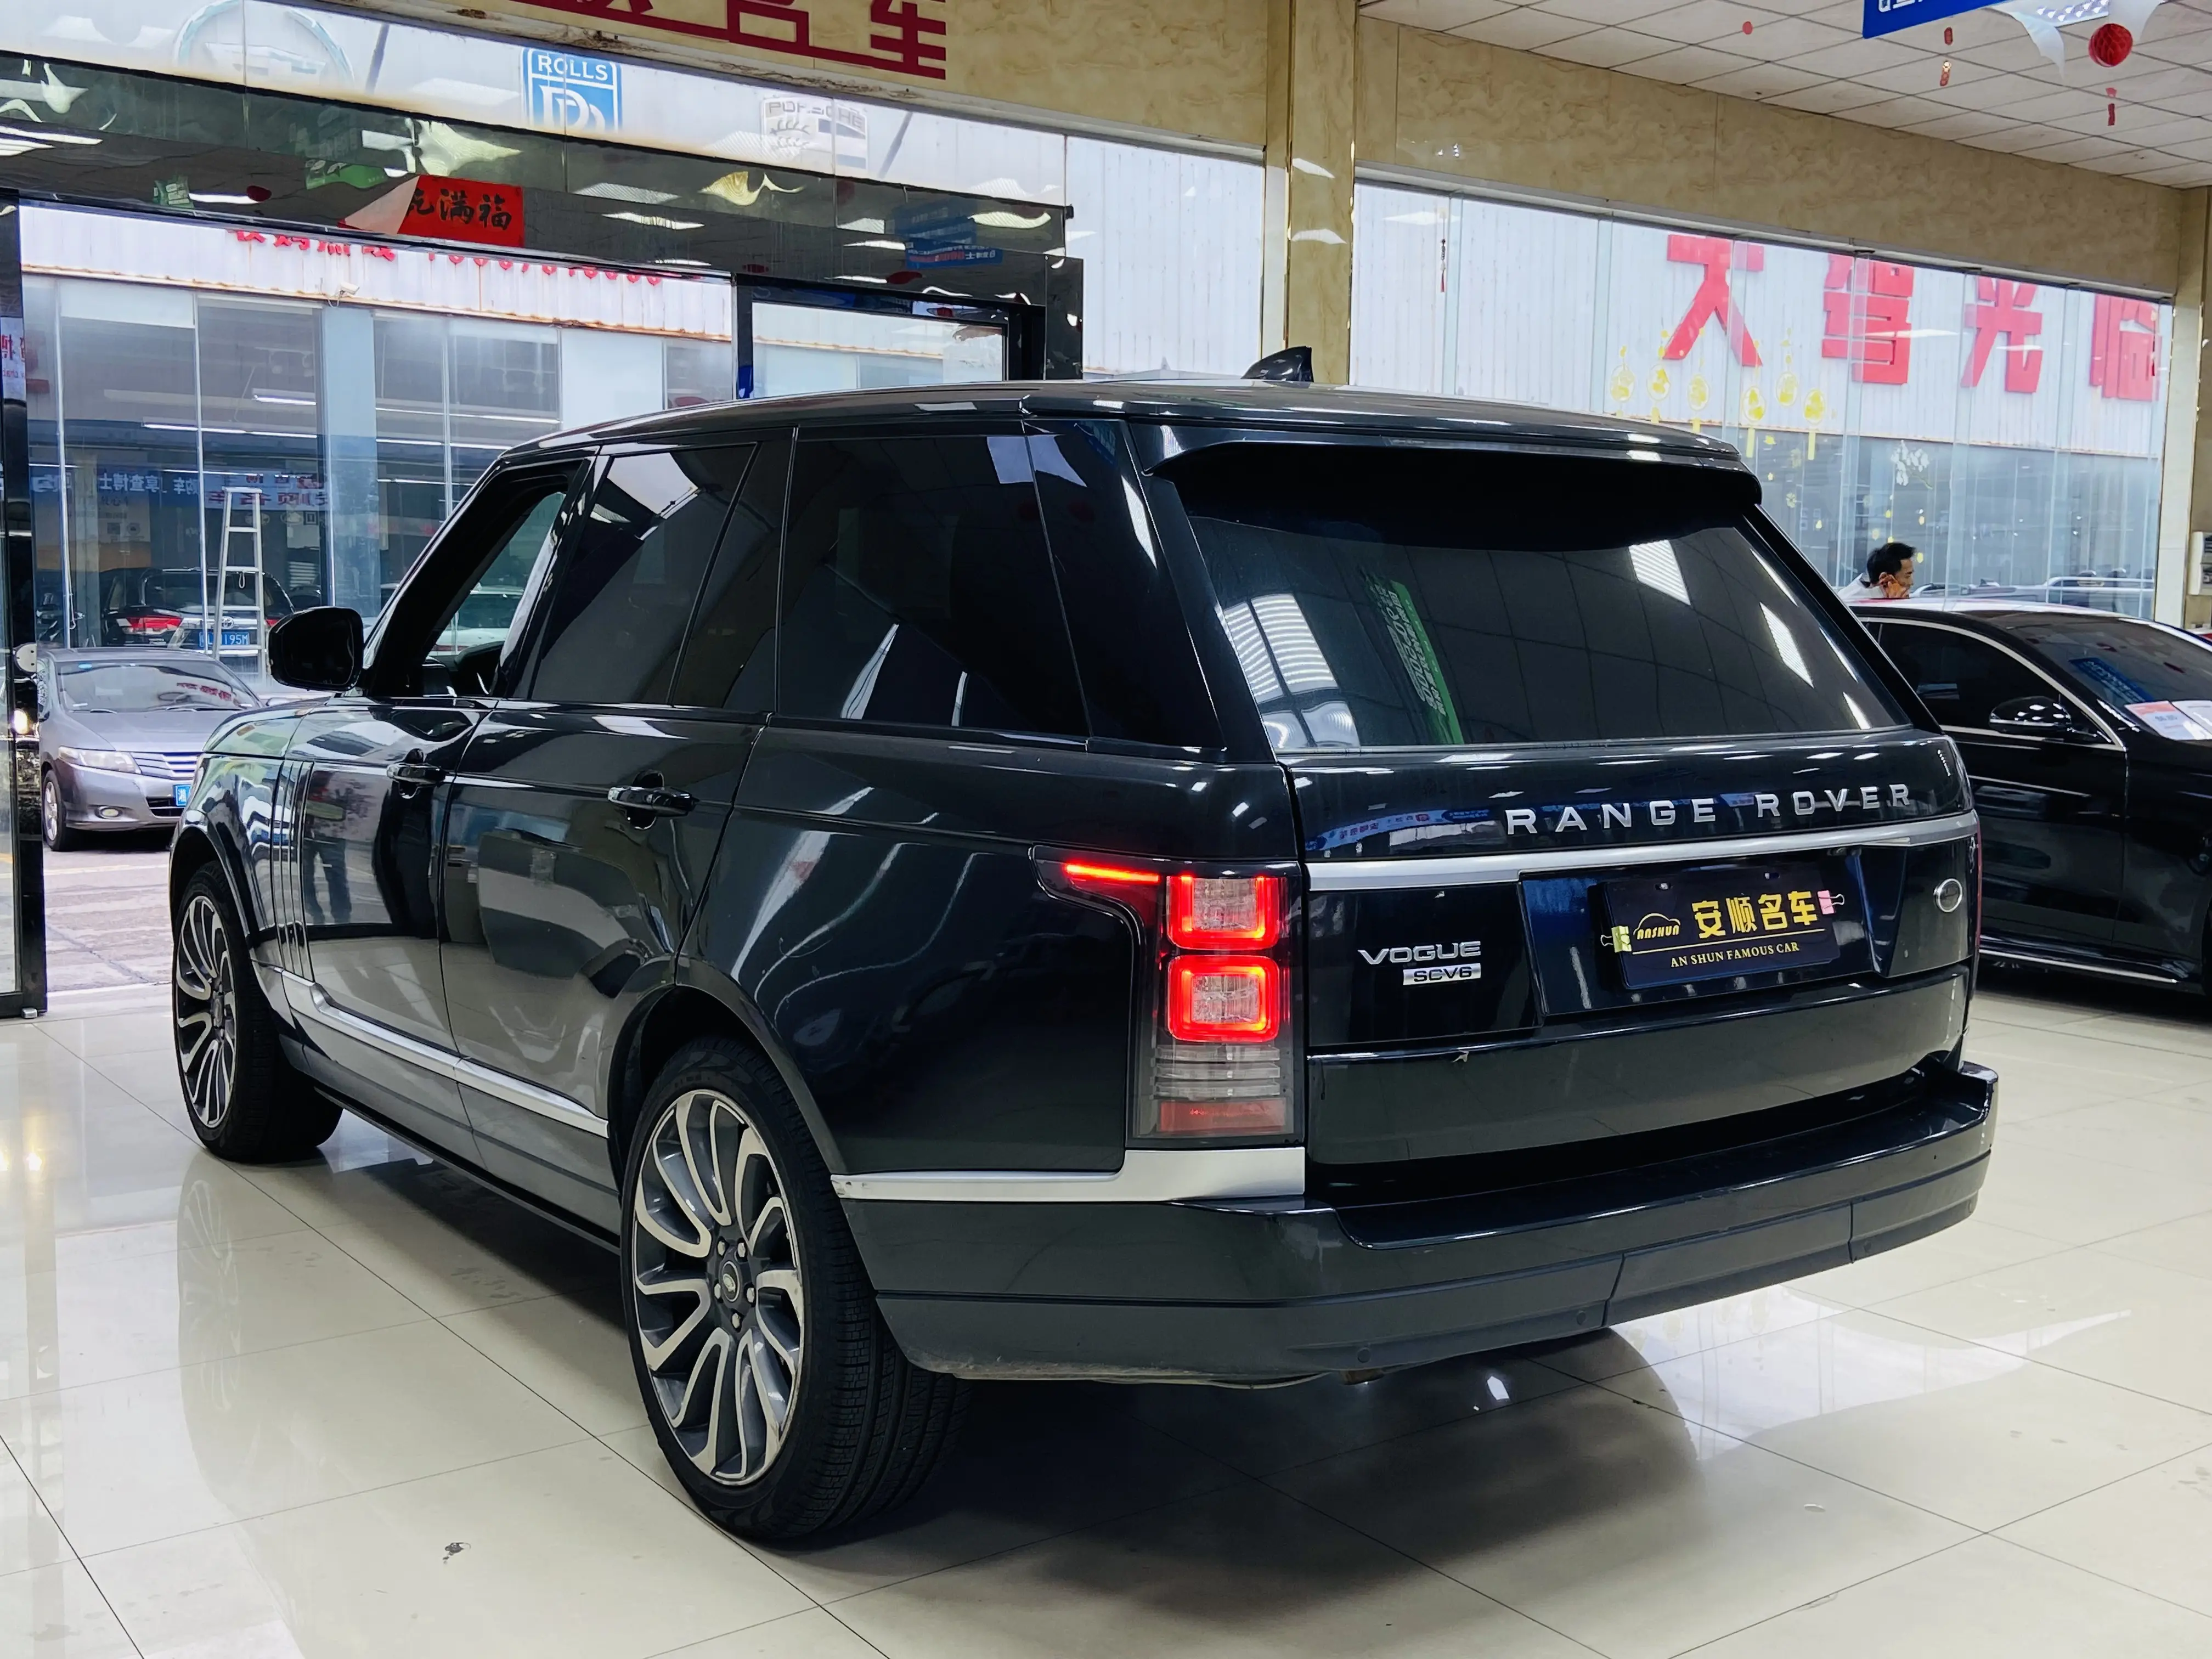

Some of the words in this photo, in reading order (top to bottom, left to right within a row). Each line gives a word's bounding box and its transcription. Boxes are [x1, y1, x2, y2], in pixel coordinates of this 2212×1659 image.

[537, 54, 608, 81] ROLLS
[1505, 797, 1716, 835] RANGE
[1755, 783, 1910, 818] ROVER
[1691, 890, 1818, 939] 安顺名车
[1357, 941, 1481, 965] VOGUE
[1671, 956, 1687, 968] AN
[1691, 951, 1724, 966] SHUN
[1726, 945, 1774, 961] FAMOUS
[1776, 941, 1799, 953] CAR
[1413, 966, 1472, 982] SCV6
